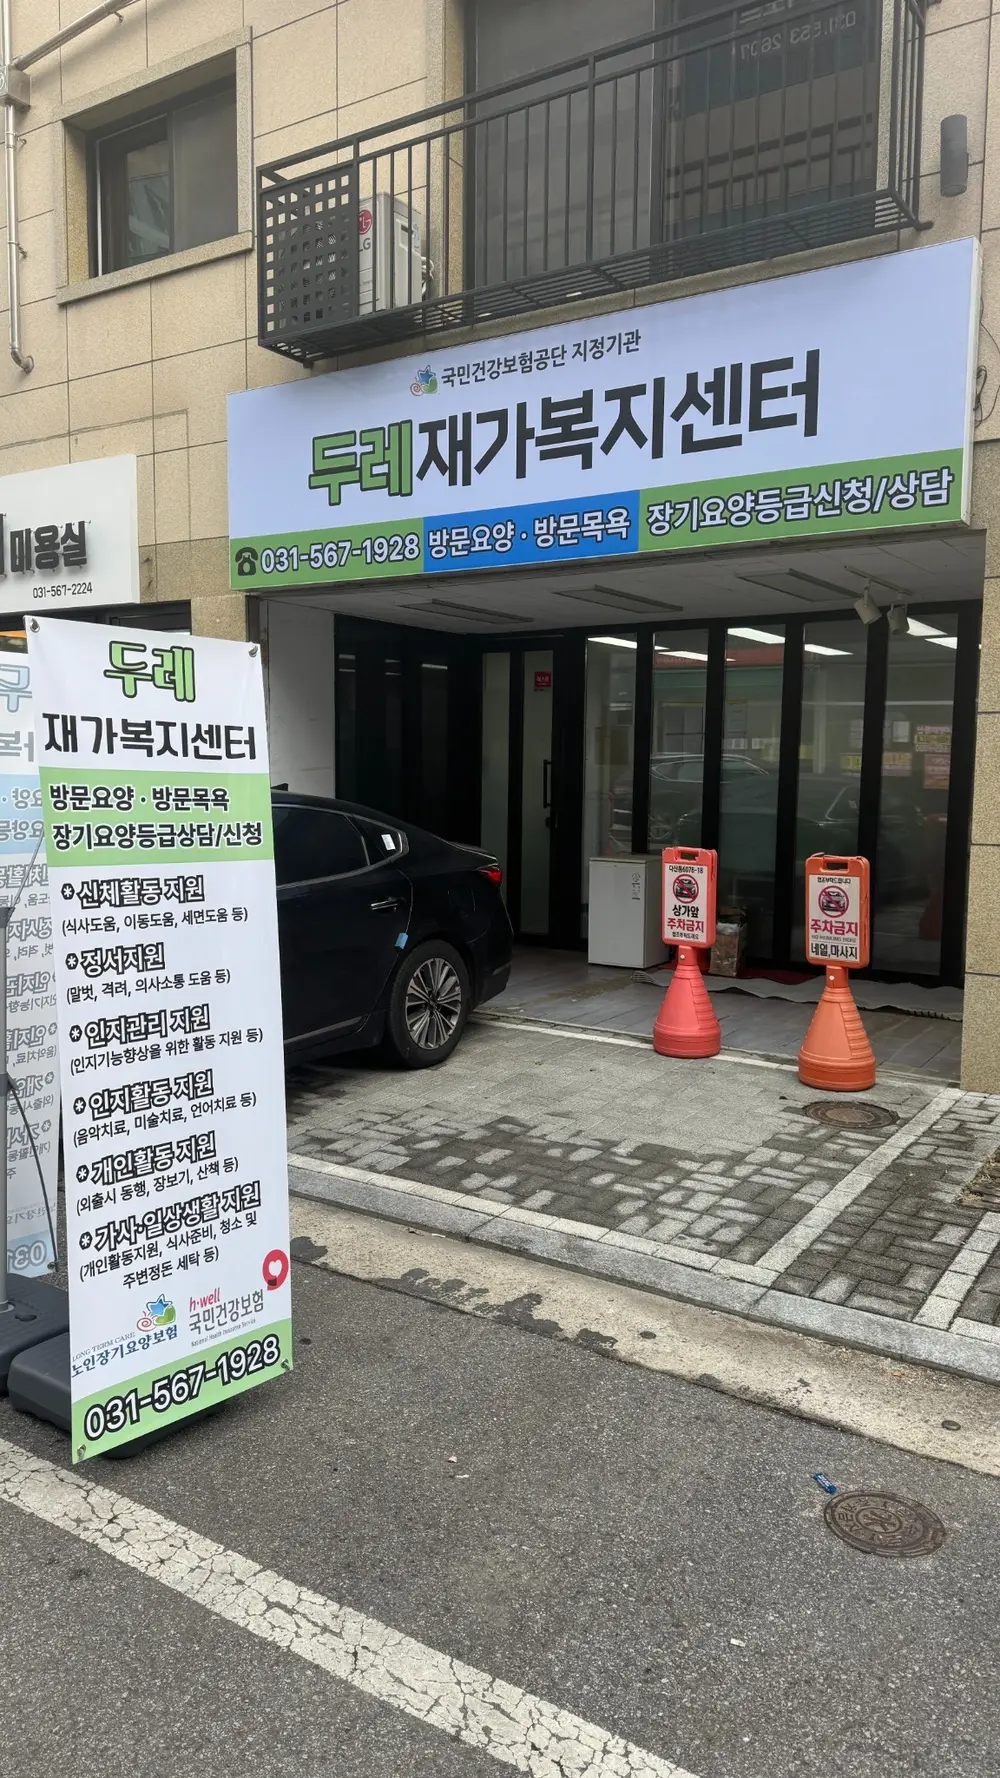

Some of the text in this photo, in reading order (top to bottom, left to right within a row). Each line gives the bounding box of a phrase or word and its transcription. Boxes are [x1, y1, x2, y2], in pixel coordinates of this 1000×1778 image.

[441, 330, 641, 388] 국민건강보험공단 지정기관
[647, 467, 953, 536] 장기요양등급신청/상담
[10, 521, 87, 572] 미용실
[259, 535, 420, 573] 031-567-1928
[428, 522, 515, 559] 방문요양
[533, 506, 630, 546] 방문목욕
[33, 582, 93, 598] 031-567-2224
[103, 640, 195, 703] 두레
[42, 713, 256, 760] 재가복지센터
[50, 784, 134, 811] 방문요양
[152, 787, 230, 812] 방문목욕
[52, 822, 262, 850] 장기요양등급상담/신청
[76, 875, 205, 909] 신체활동 지원
[672, 904, 699, 918] 상가앞
[62, 907, 248, 936] (식사도움, 이동도움, 세면도움 등)
[667, 918, 704, 934] 주차금지
[811, 919, 858, 937] 주차금지
[80, 942, 165, 977] 정서지원
[67, 968, 231, 1004] (말벗, 격려, 의사소통 도움 등)
[84, 1004, 210, 1049] 인지관리 지원
[71, 1028, 263, 1075] (인지기능향상을 위한 활동 지원 등)
[88, 1069, 214, 1120] 인지활동 지원
[73, 1092, 257, 1147] (음악치료, 미술치료, 언어치료 등)
[91, 1130, 216, 1186] 개인활동 지원
[76, 1156, 239, 1216] (외출시 동행, 장보기, 산책 등)
[221, 1180, 261, 1211] 지원
[79, 1211, 257, 1282] (개인활동지원, 식사준비, 청소 및
[122, 1245, 220, 1289] 주변정돈 세탁 등)
[189, 1289, 264, 1334] 국민건강보험
[71, 1324, 178, 1378] 노인장기요양보험
[72, 1331, 136, 1362] LONG TERM CARE
[84, 1334, 280, 1441] 031-567-1928
